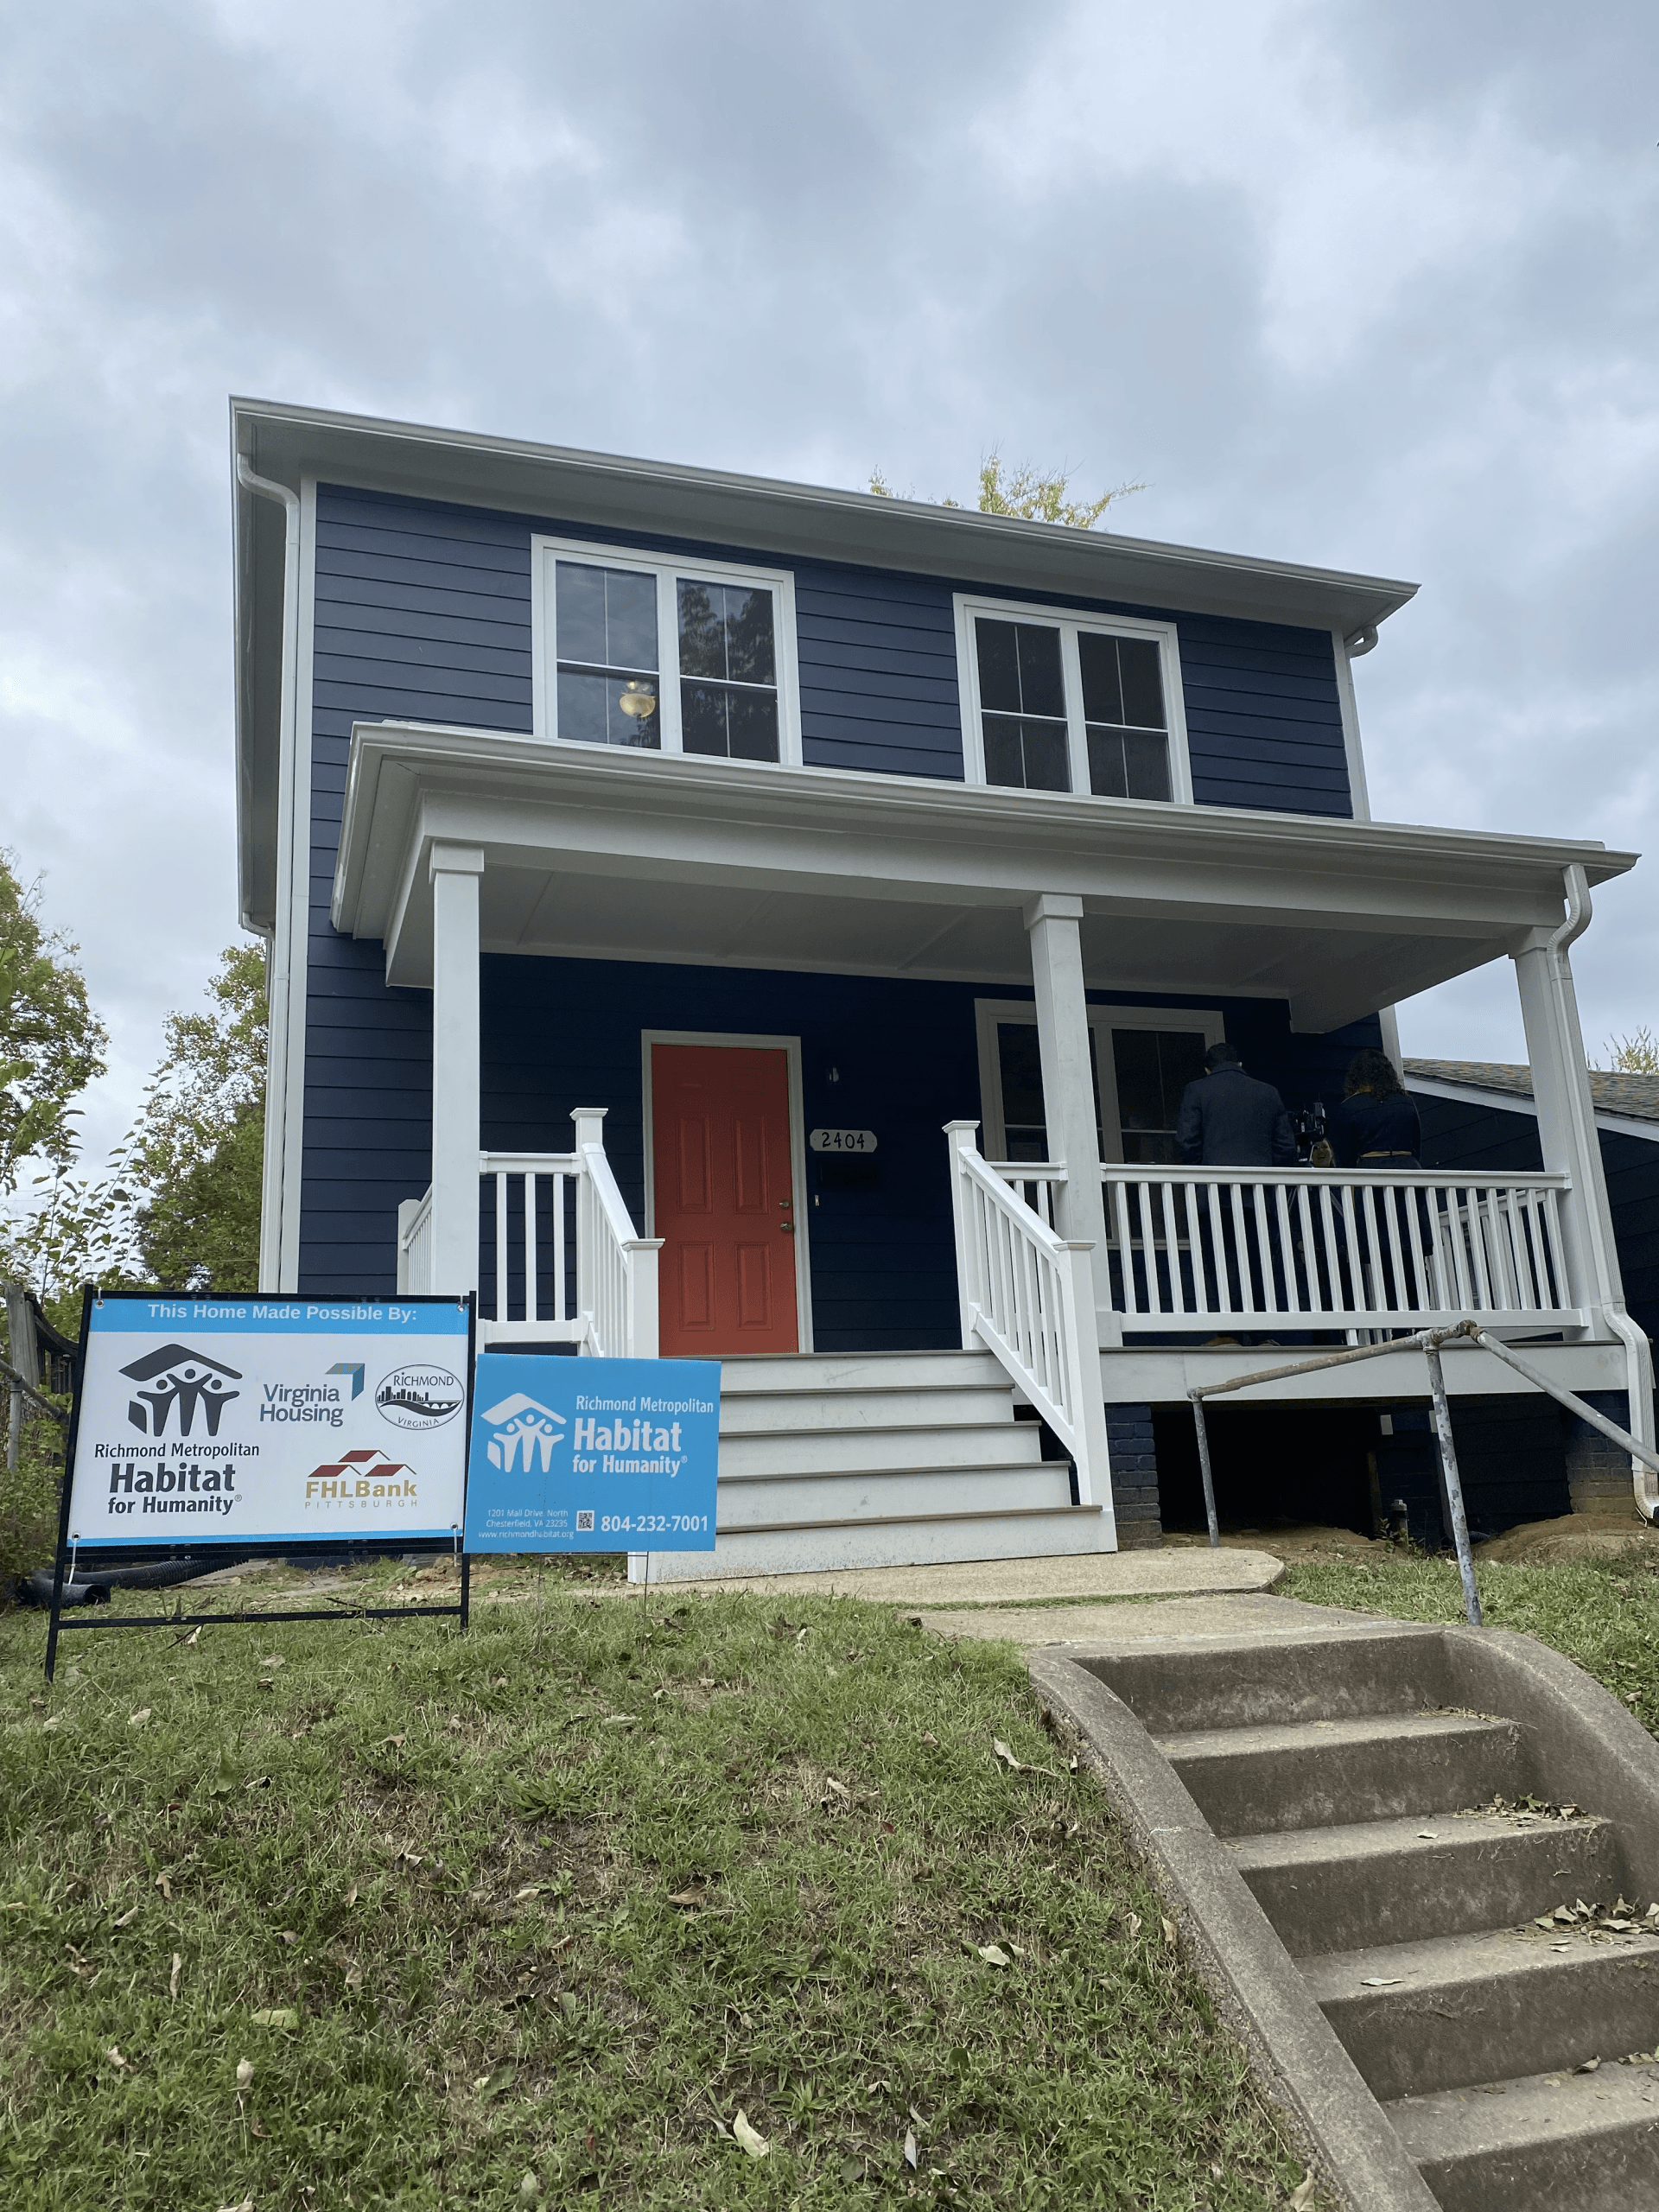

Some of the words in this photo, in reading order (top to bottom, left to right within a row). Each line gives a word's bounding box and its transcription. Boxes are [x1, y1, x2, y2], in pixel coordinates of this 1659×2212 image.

[821, 1131, 865, 1150] 2404
[147, 1303, 187, 1319] This
[193, 1305, 247, 1319] Home
[252, 1305, 301, 1320] Made
[306, 1305, 383, 1321] Possible
[387, 1306, 417, 1324] By:
[263, 1383, 340, 1408] Virginia
[576, 1395, 637, 1412] Richmond
[640, 1396, 714, 1415] Metropolitan
[259, 1403, 344, 1427] Housing
[397, 1416, 440, 1428] VIRGINIA
[573, 1417, 683, 1452] Habitat
[94, 1442, 167, 1459] Richmond
[170, 1442, 260, 1460] Metropolitan
[572, 1454, 597, 1473] for
[109, 1462, 236, 1494] Habitat
[305, 1479, 418, 1500] FHLBank
[108, 1496, 134, 1515] for
[305, 1499, 418, 1510] PITTSBURGH
[487, 1509, 505, 1517] 1201
[507, 1509, 523, 1517] Mall
[547, 1509, 569, 1517] North
[534, 1519, 544, 1528] VA
[545, 1519, 569, 1528] 23235
[601, 1515, 709, 1533] 804-232-7001
[479, 1530, 574, 1540] www.richmondhabitat.org
